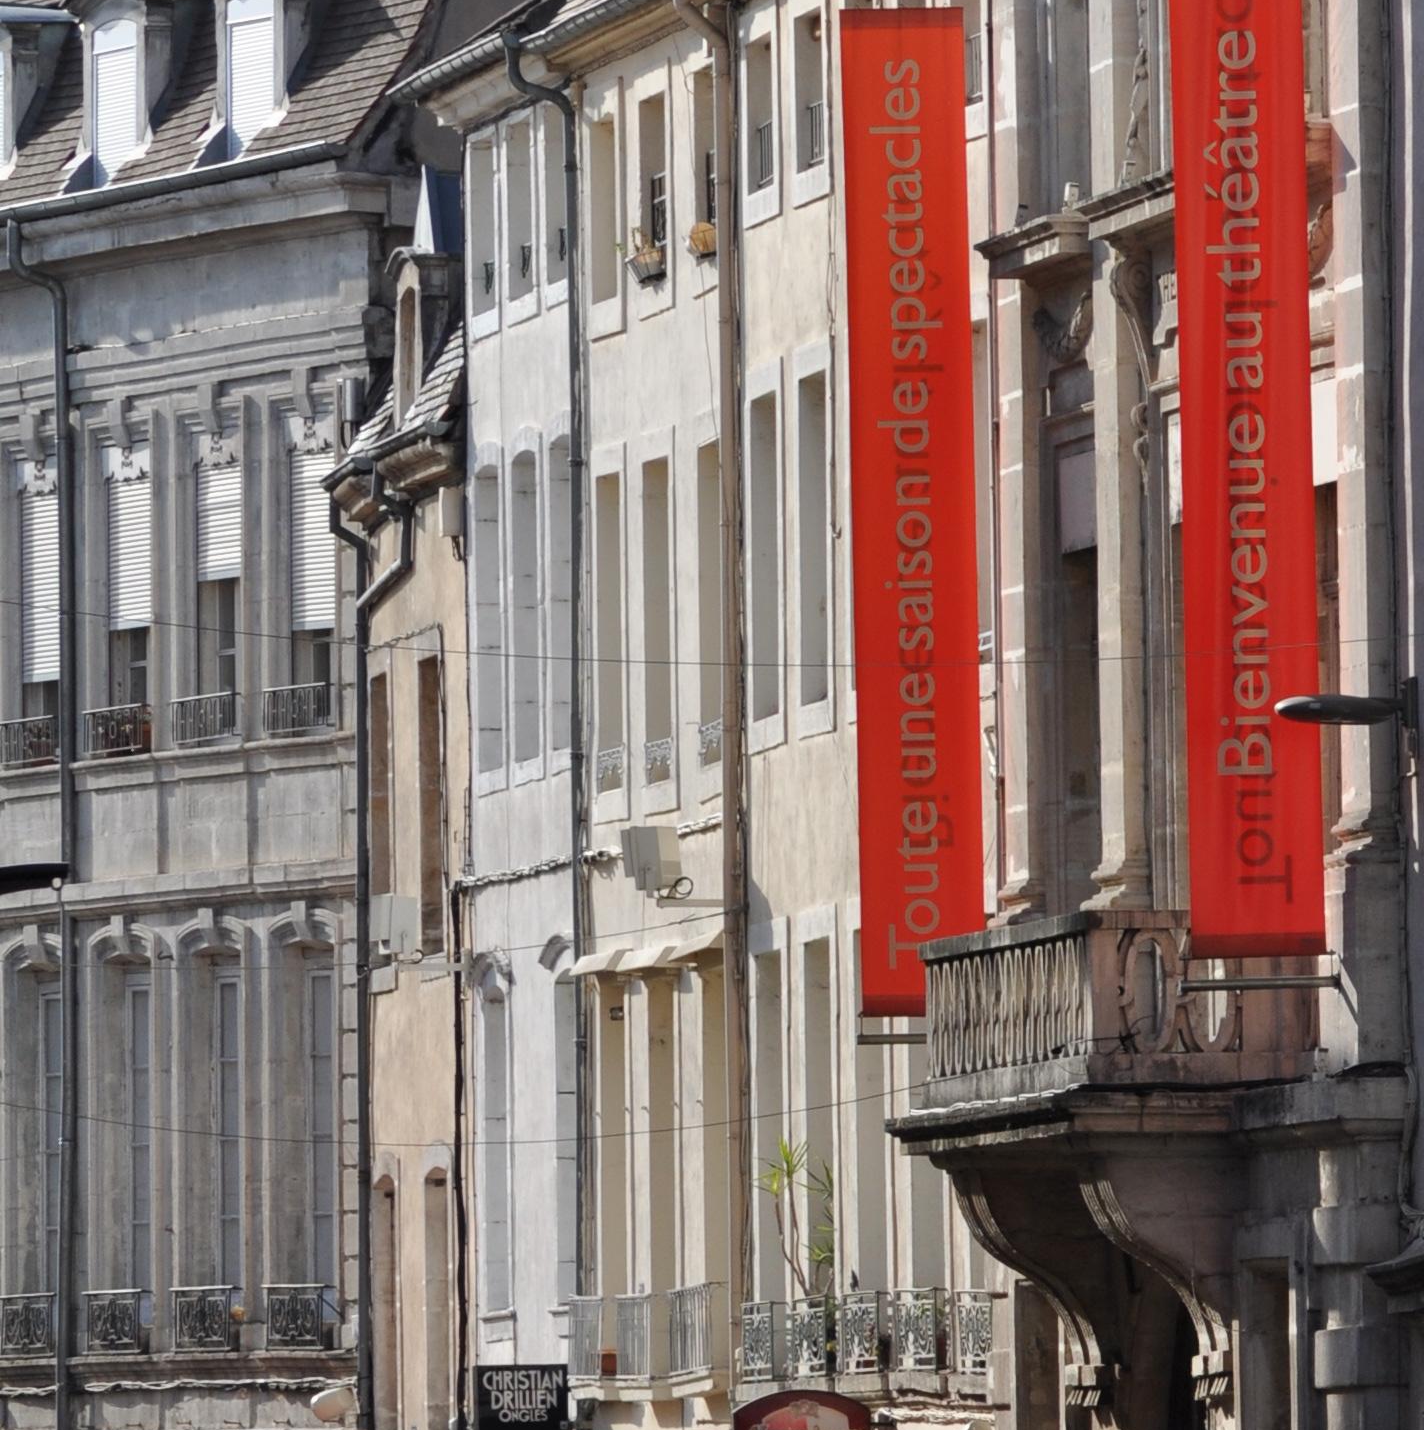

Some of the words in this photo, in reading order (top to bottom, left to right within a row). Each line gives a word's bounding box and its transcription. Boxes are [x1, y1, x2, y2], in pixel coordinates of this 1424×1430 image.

[868, 57, 943, 364] spectacles
[1203, 29, 1264, 286] théâtre
[1224, 310, 1265, 388] au
[877, 377, 931, 455] de
[884, 472, 935, 652] saison
[1217, 411, 1273, 777] Bienvenue
[899, 669, 936, 779] une
[889, 800, 941, 969] Toute
[483, 1370, 563, 1391] CHRISTIAN
[491, 1390, 557, 1410] DRILLIEN
[499, 1409, 548, 1422] ONGLES
